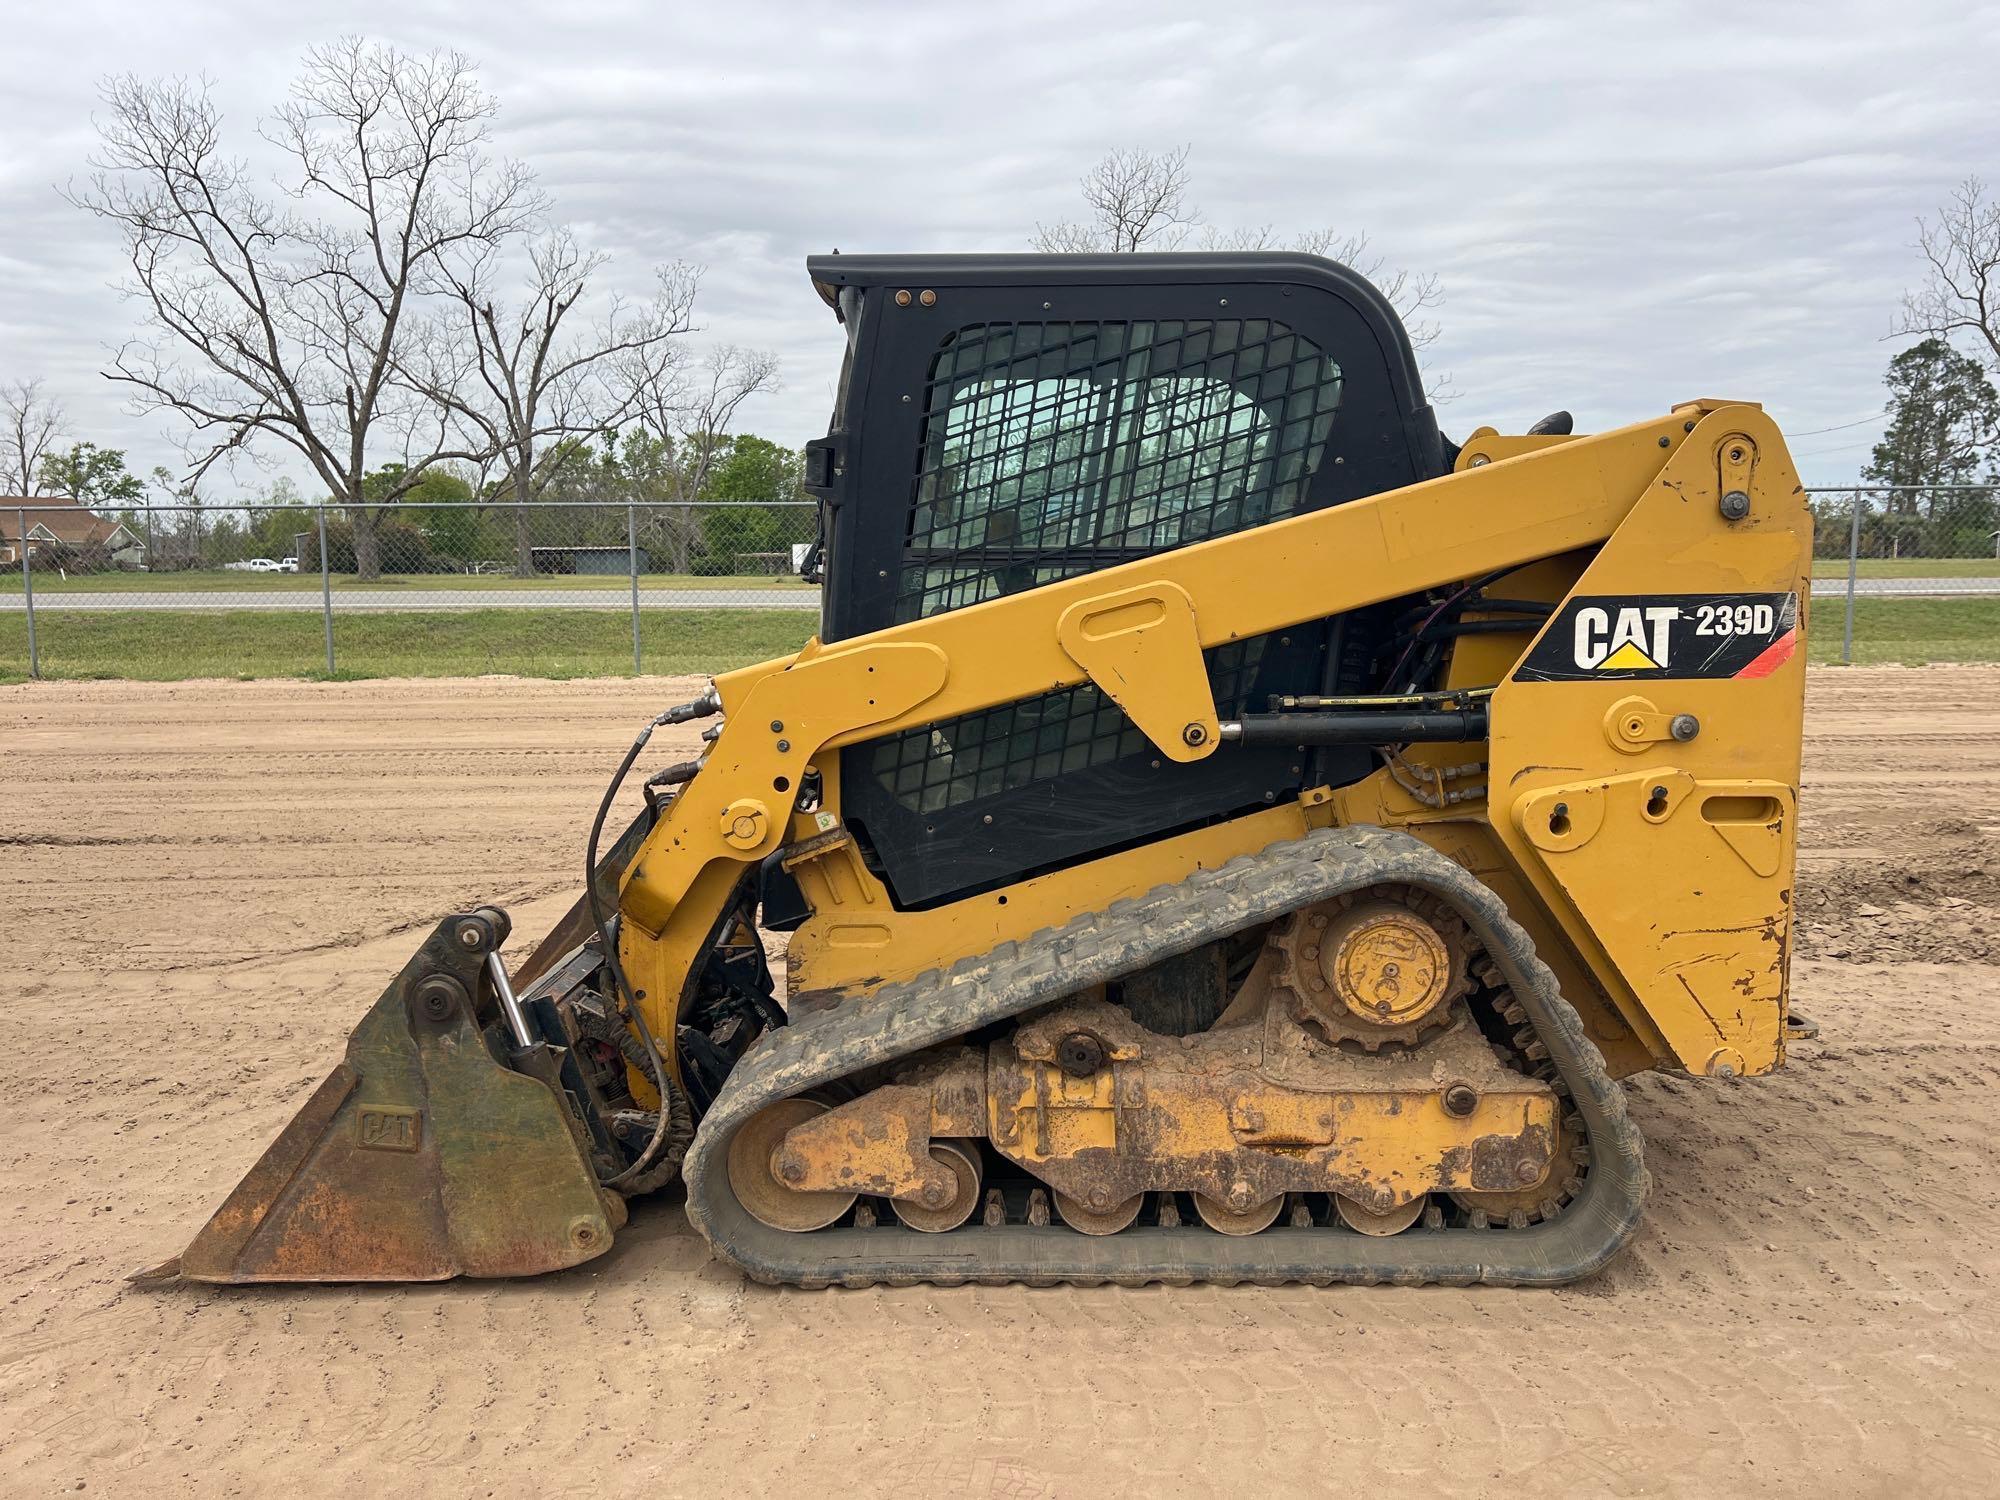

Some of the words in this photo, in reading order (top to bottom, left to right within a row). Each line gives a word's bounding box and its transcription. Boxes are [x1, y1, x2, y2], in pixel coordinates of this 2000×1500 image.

[1574, 607, 1679, 670] CAT
[1695, 605, 1773, 636] 239D
[361, 1112, 415, 1145] CAT
